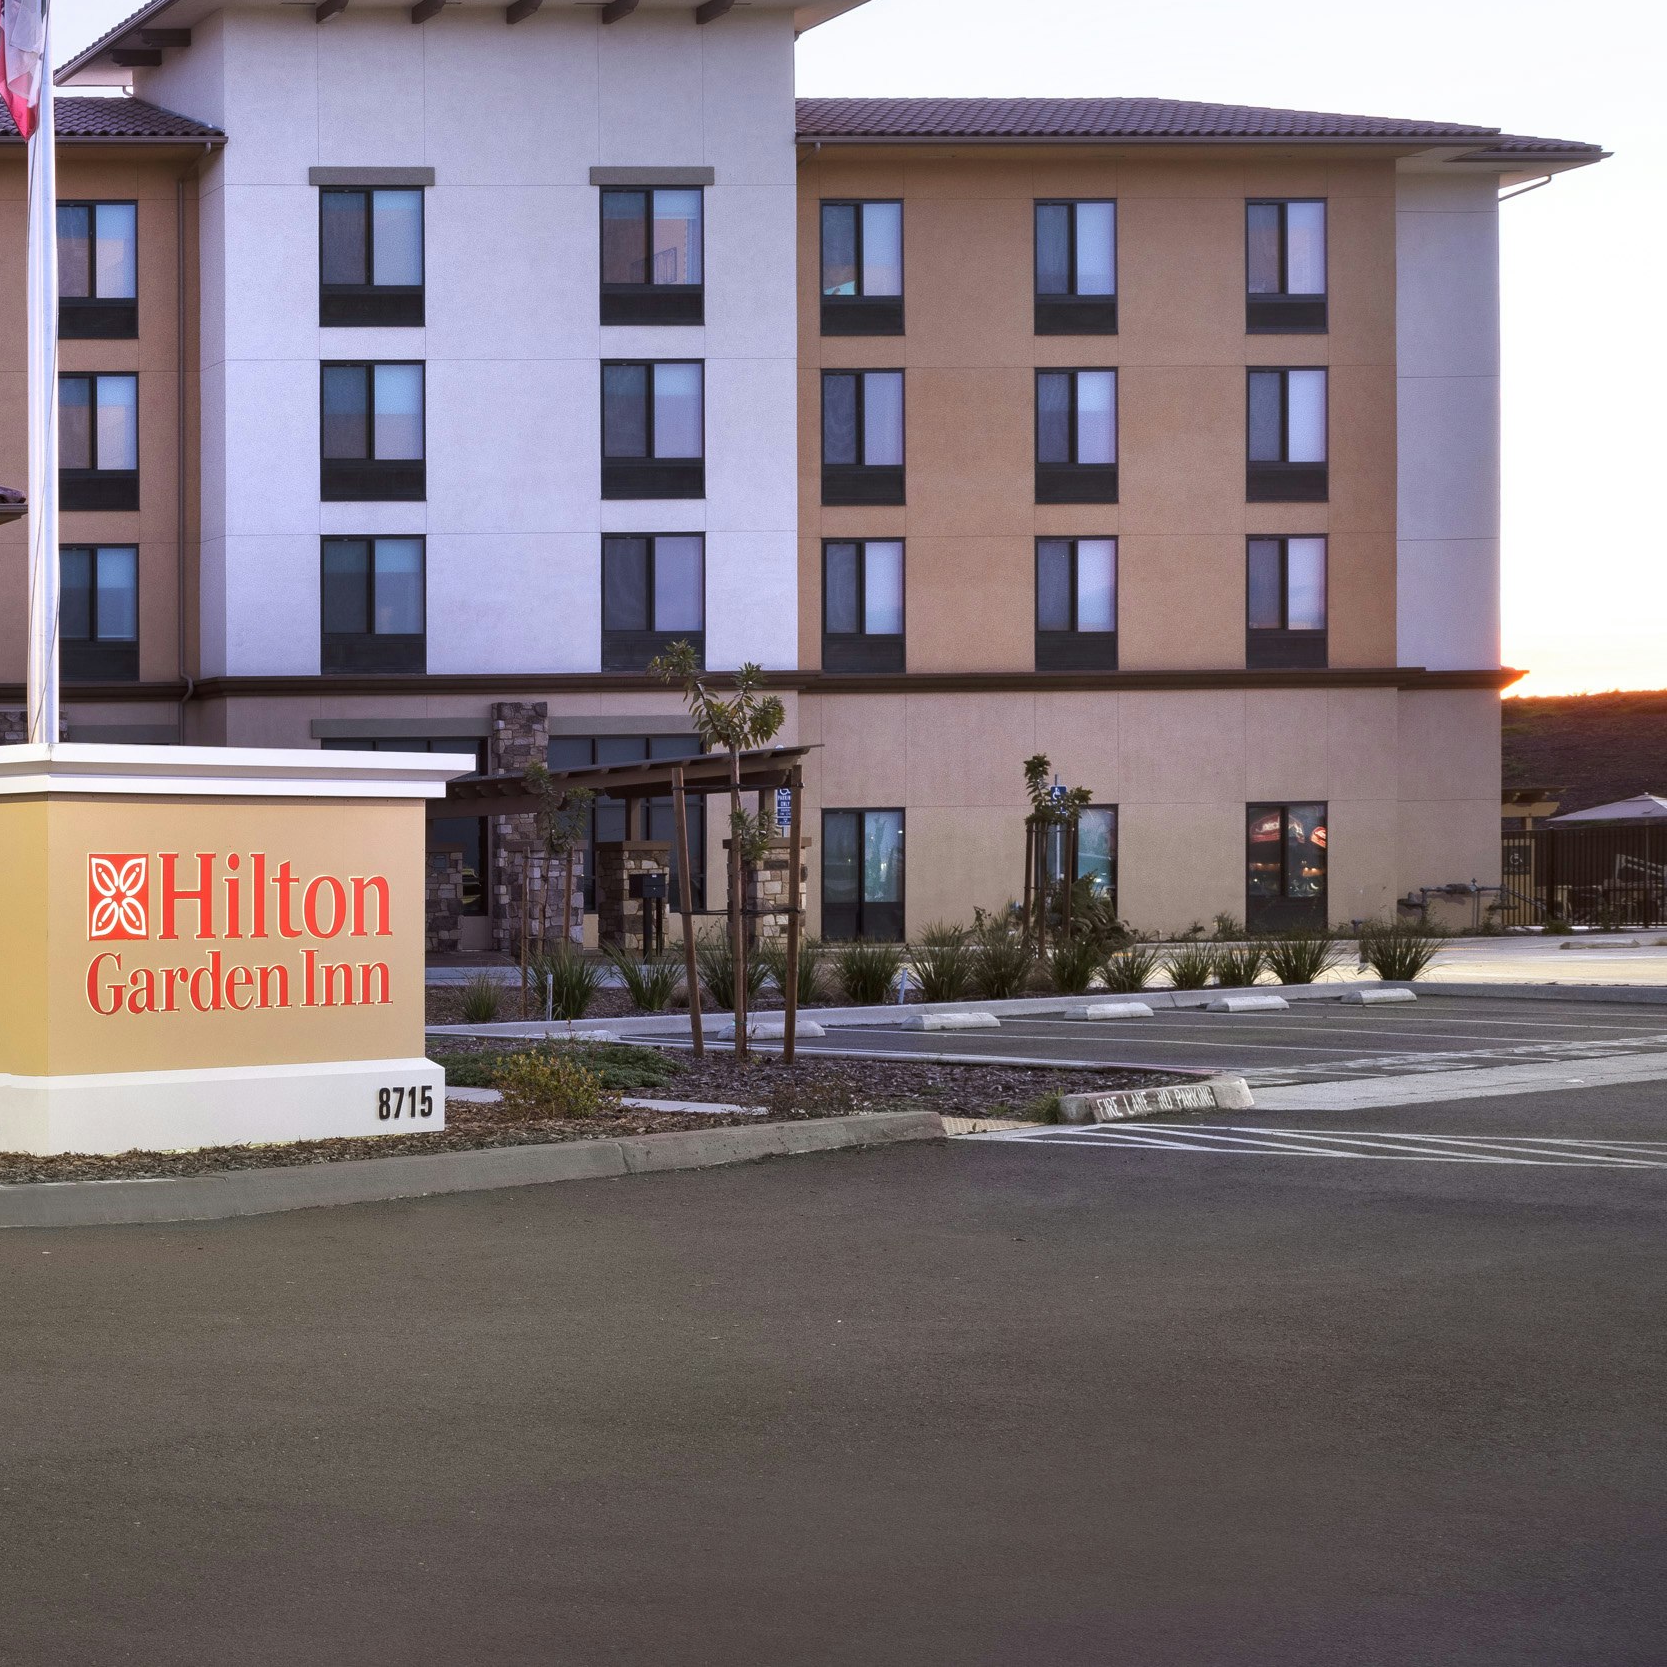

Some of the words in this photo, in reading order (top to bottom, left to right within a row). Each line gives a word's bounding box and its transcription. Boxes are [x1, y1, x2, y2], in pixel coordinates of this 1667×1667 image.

[157, 852, 393, 940] Hilton
[86, 950, 292, 1016] Garden
[299, 948, 393, 1008] Inn
[378, 1085, 433, 1120] 8715
[1096, 1097, 1123, 1120] FIRE
[1123, 1091, 1151, 1113] LANE
[1157, 1090, 1173, 1109] NO
[1174, 1086, 1216, 1108] PARKING
